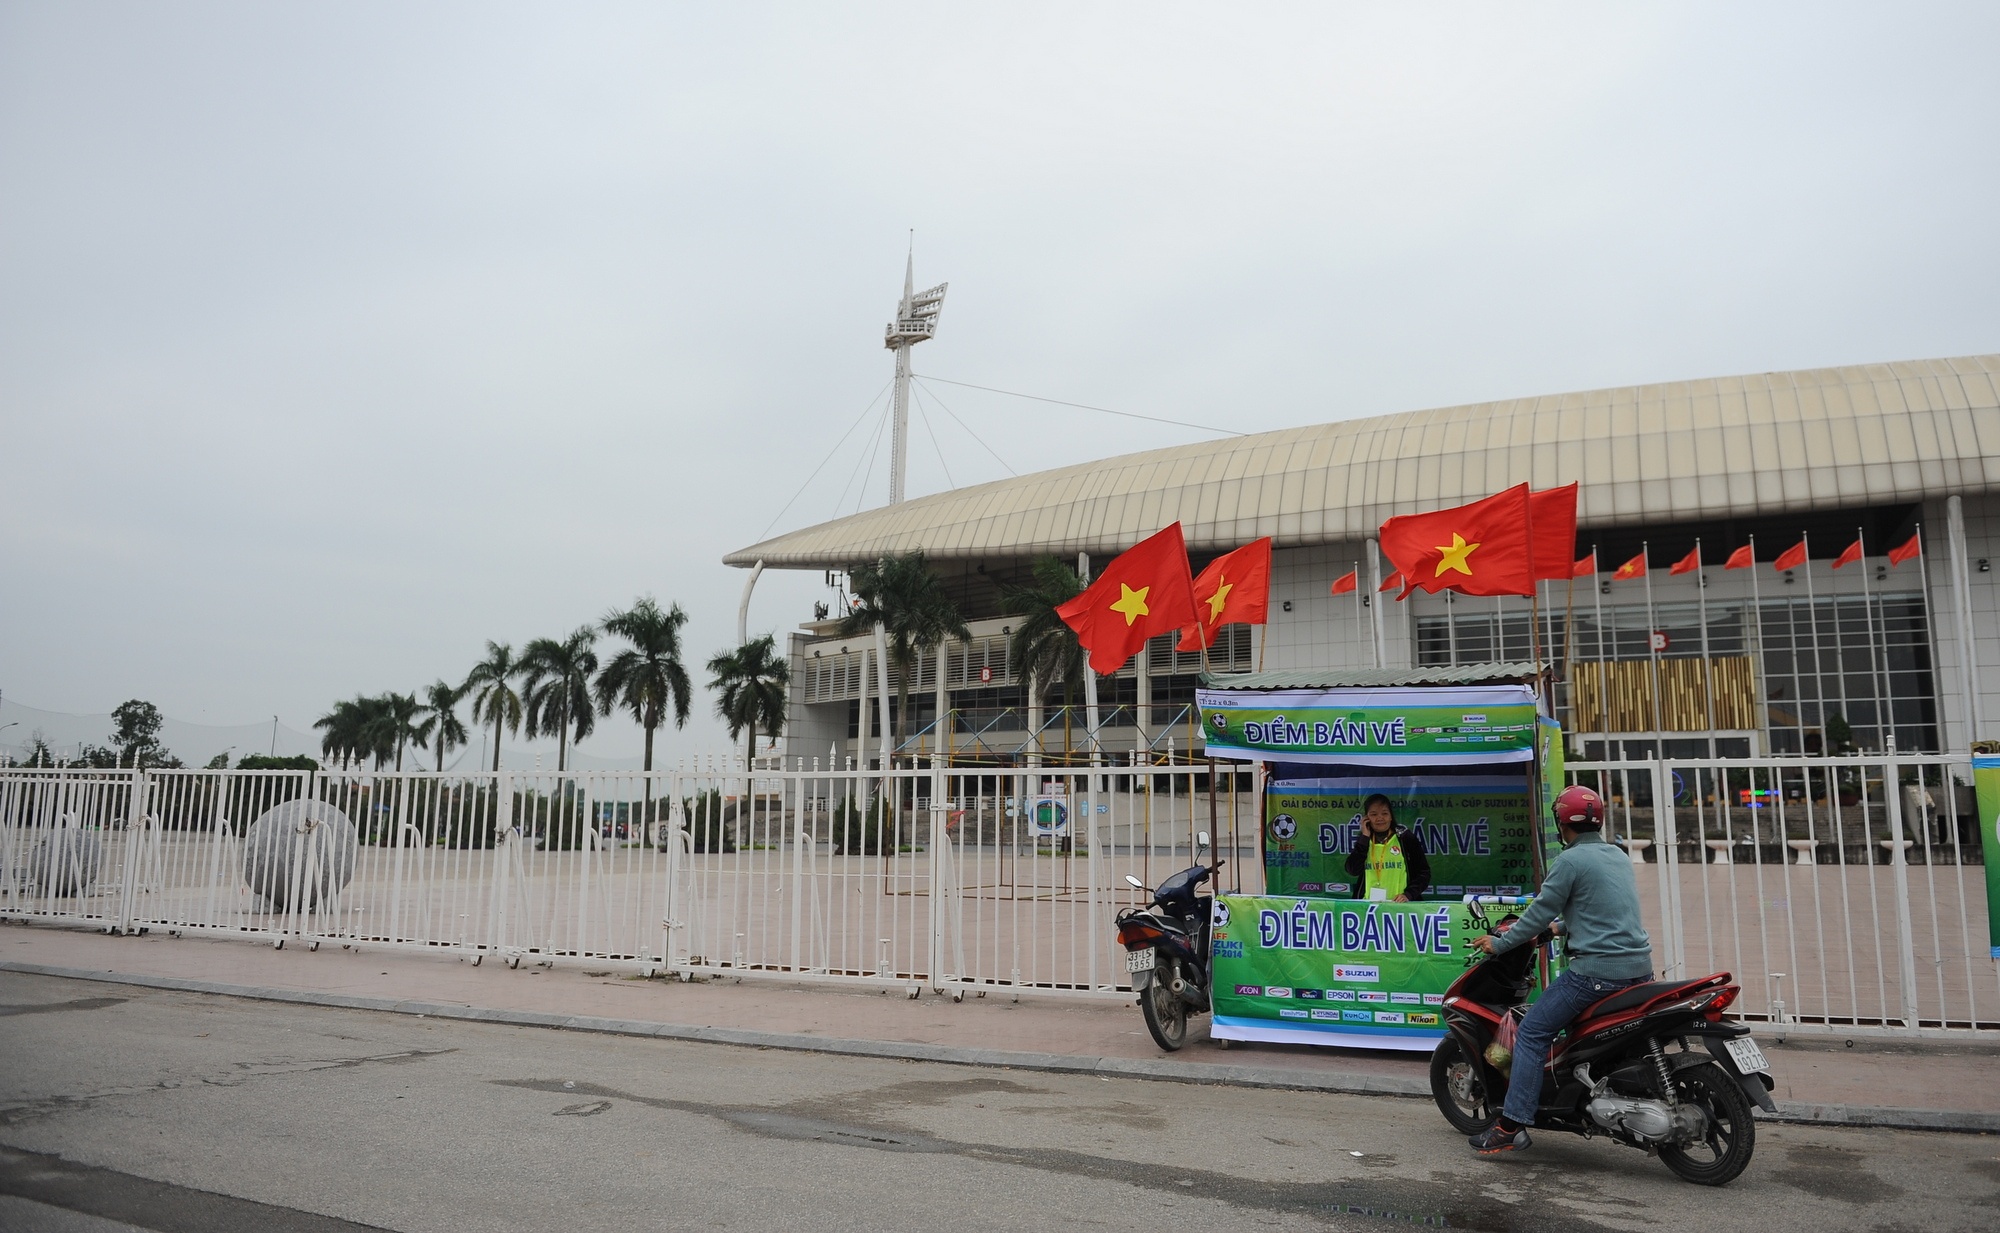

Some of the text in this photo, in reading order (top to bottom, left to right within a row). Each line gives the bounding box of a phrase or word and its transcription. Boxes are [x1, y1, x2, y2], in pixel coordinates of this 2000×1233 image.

[1651, 634, 1666, 649] B
[982, 669, 990, 681] B
[1244, 714, 1406, 746] ĐIỂM BÁN VÉ
[1302, 798, 1328, 809] BÓNG
[1331, 797, 1344, 809] ĐÁ
[1421, 799, 1443, 808] NAM
[1446, 797, 1453, 807] Á
[1461, 797, 1481, 808] CÚP
[1484, 799, 1517, 808] SUZUKI
[1318, 813, 1490, 856] ĐIỂ ÁN VÉ
[1500, 828, 1532, 838] 300.
[1501, 843, 1533, 853] 250.
[1258, 899, 1451, 954] ĐIỂM BÁN VÉ
[1213, 940, 1243, 949] ZUKI
[1222, 950, 1242, 958] 2014
[1128, 959, 1150, 970] 2955
[1327, 991, 1354, 999] EPSON
[1380, 1014, 1400, 1022] mitre
[1410, 1015, 1435, 1024] Nikon
